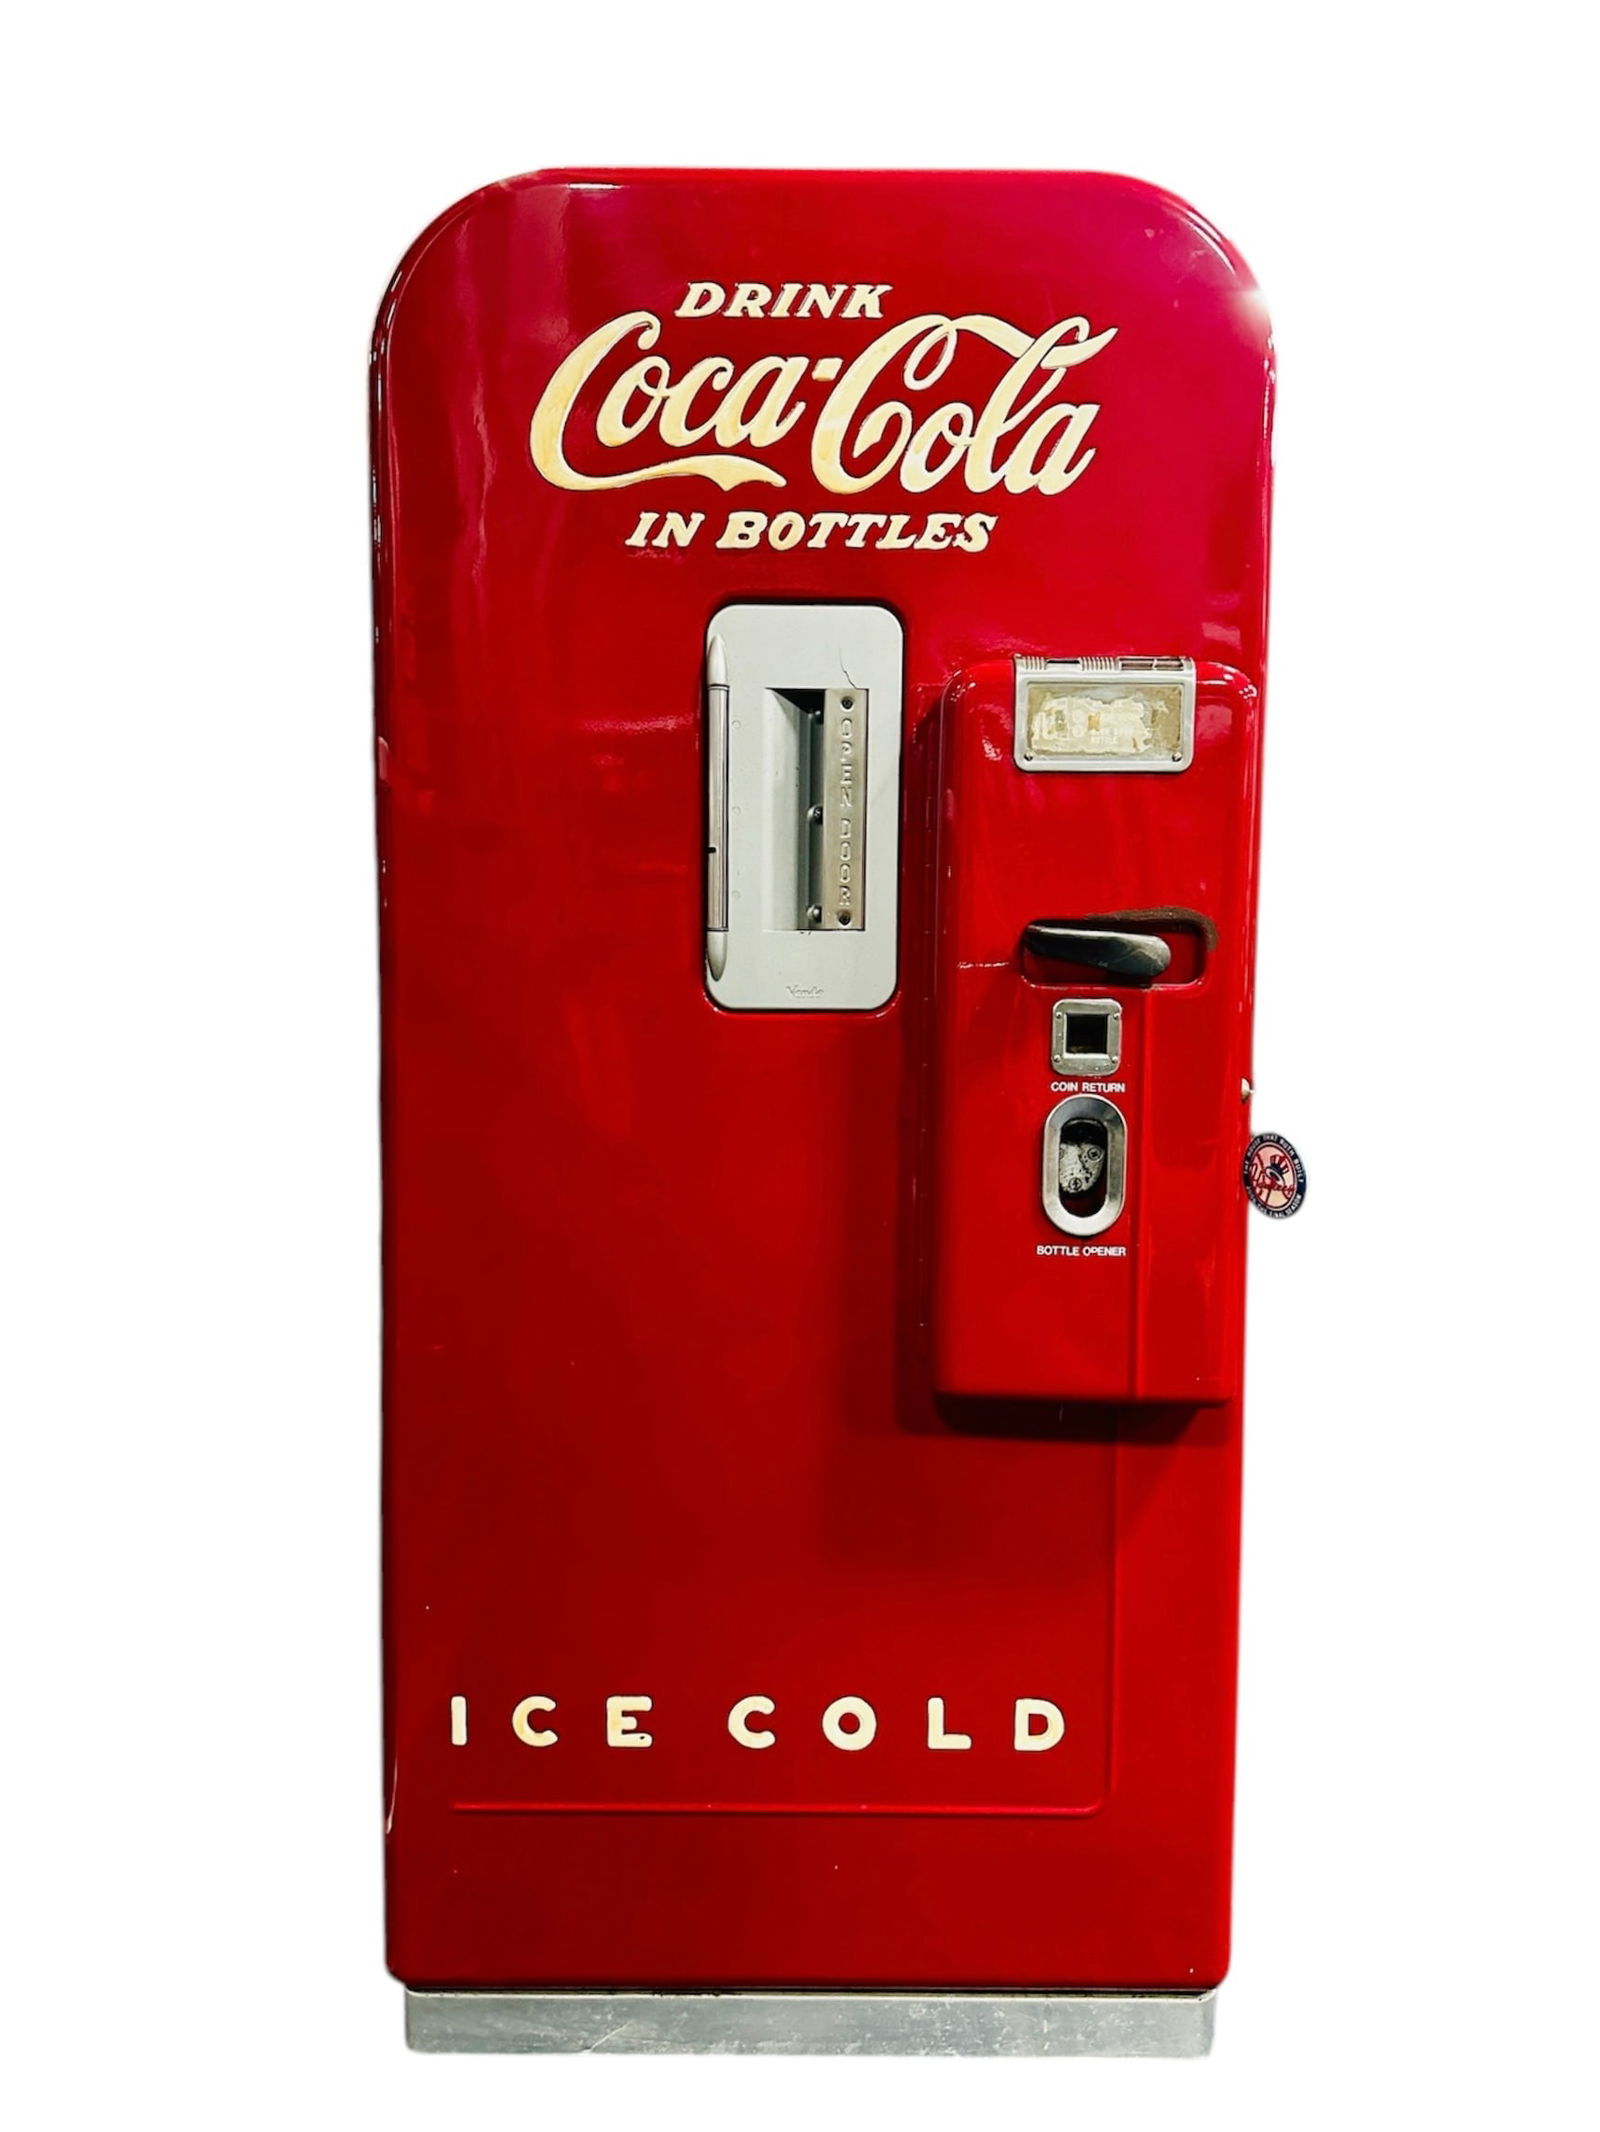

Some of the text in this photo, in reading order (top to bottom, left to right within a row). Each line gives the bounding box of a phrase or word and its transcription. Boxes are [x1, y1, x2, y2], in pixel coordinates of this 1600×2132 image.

[675, 283, 892, 318] DRINK
[530, 310, 1118, 495] Coca-Cola
[625, 512, 998, 552] IN BOTTLES
[839, 717, 853, 906] OPEN DOOR
[1051, 1082, 1125, 1092] COIN RETURN
[1037, 1246, 1126, 1256] BOTTLE OPENER
[451, 1696, 1064, 1751] ICE COLD
